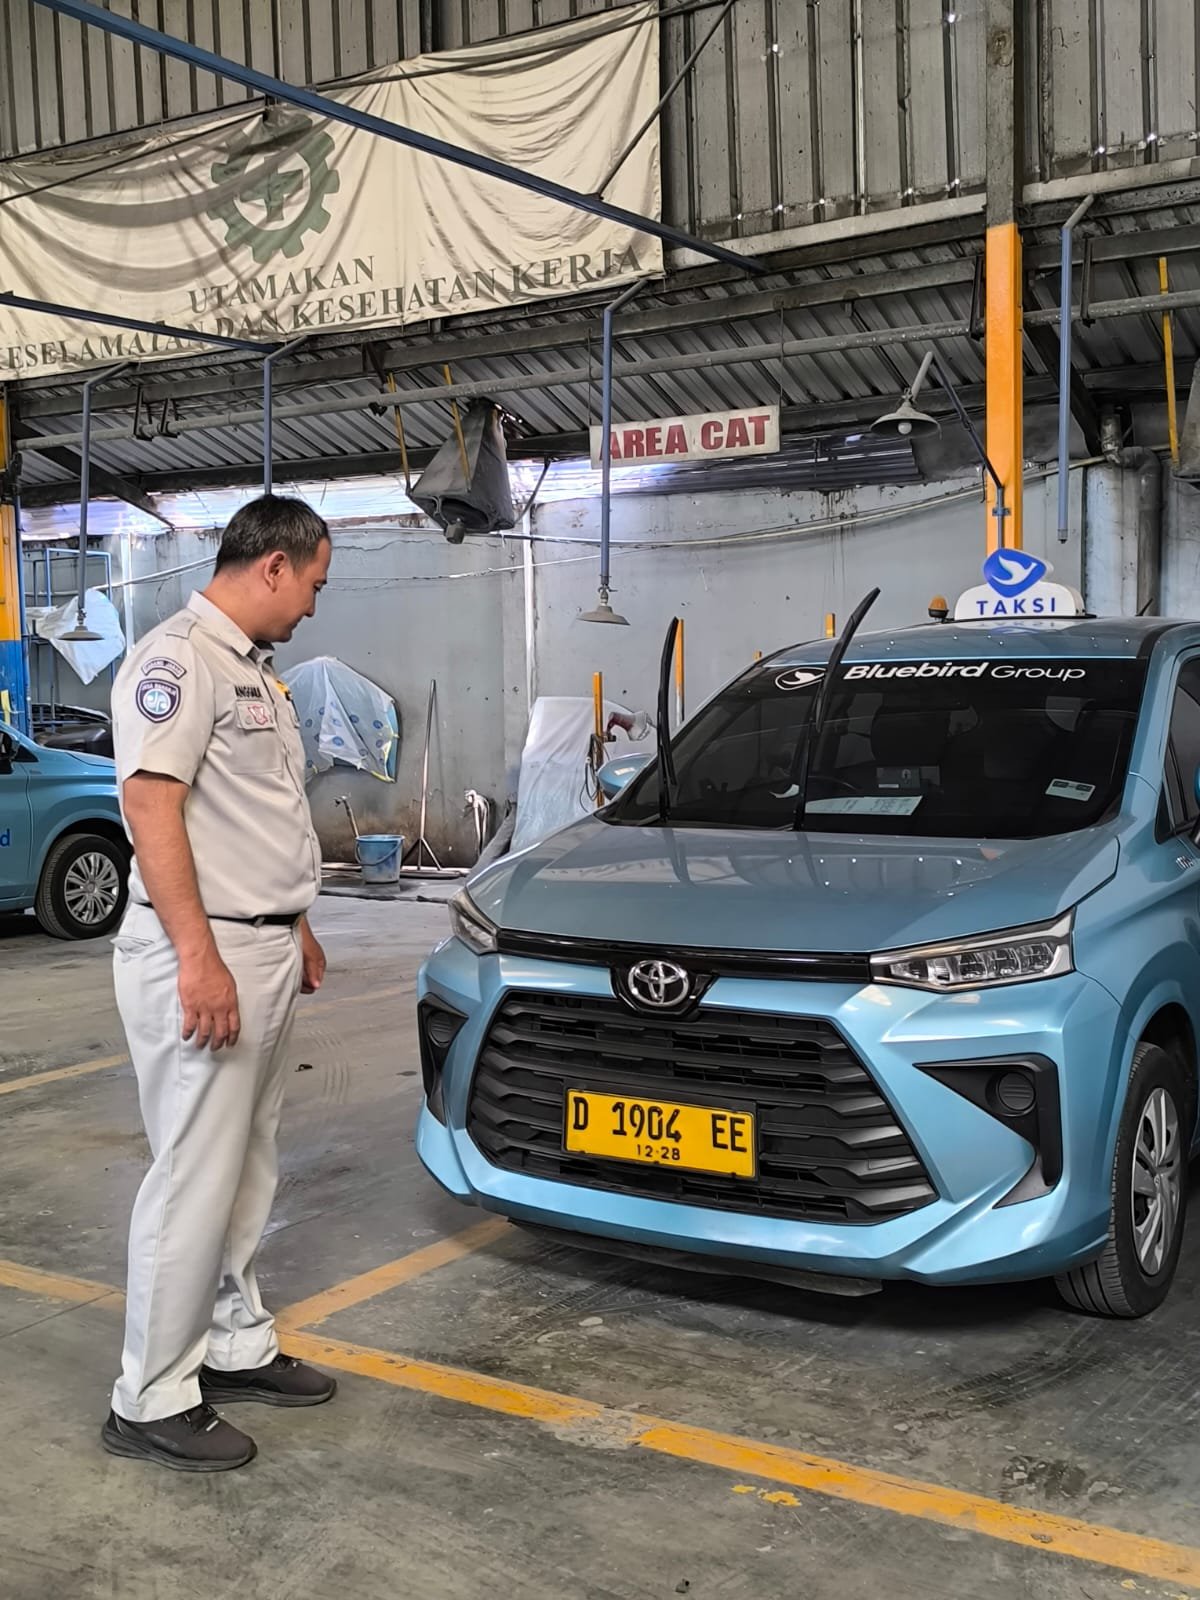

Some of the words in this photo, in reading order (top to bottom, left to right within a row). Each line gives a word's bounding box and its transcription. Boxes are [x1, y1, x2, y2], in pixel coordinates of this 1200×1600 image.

[188, 256, 374, 314] UTAMAKAN
[215, 308, 288, 338] DAN
[291, 268, 496, 330] KESEHATAN
[511, 245, 642, 293] KERJA
[701, 415, 770, 450] CAT
[976, 597, 1055, 615] TAKSI
[843, 662, 989, 681] Bluebird
[991, 665, 1087, 682] Group
[573, 1096, 588, 1130] D
[612, 1101, 682, 1143] 1904
[711, 1113, 747, 1153] EE
